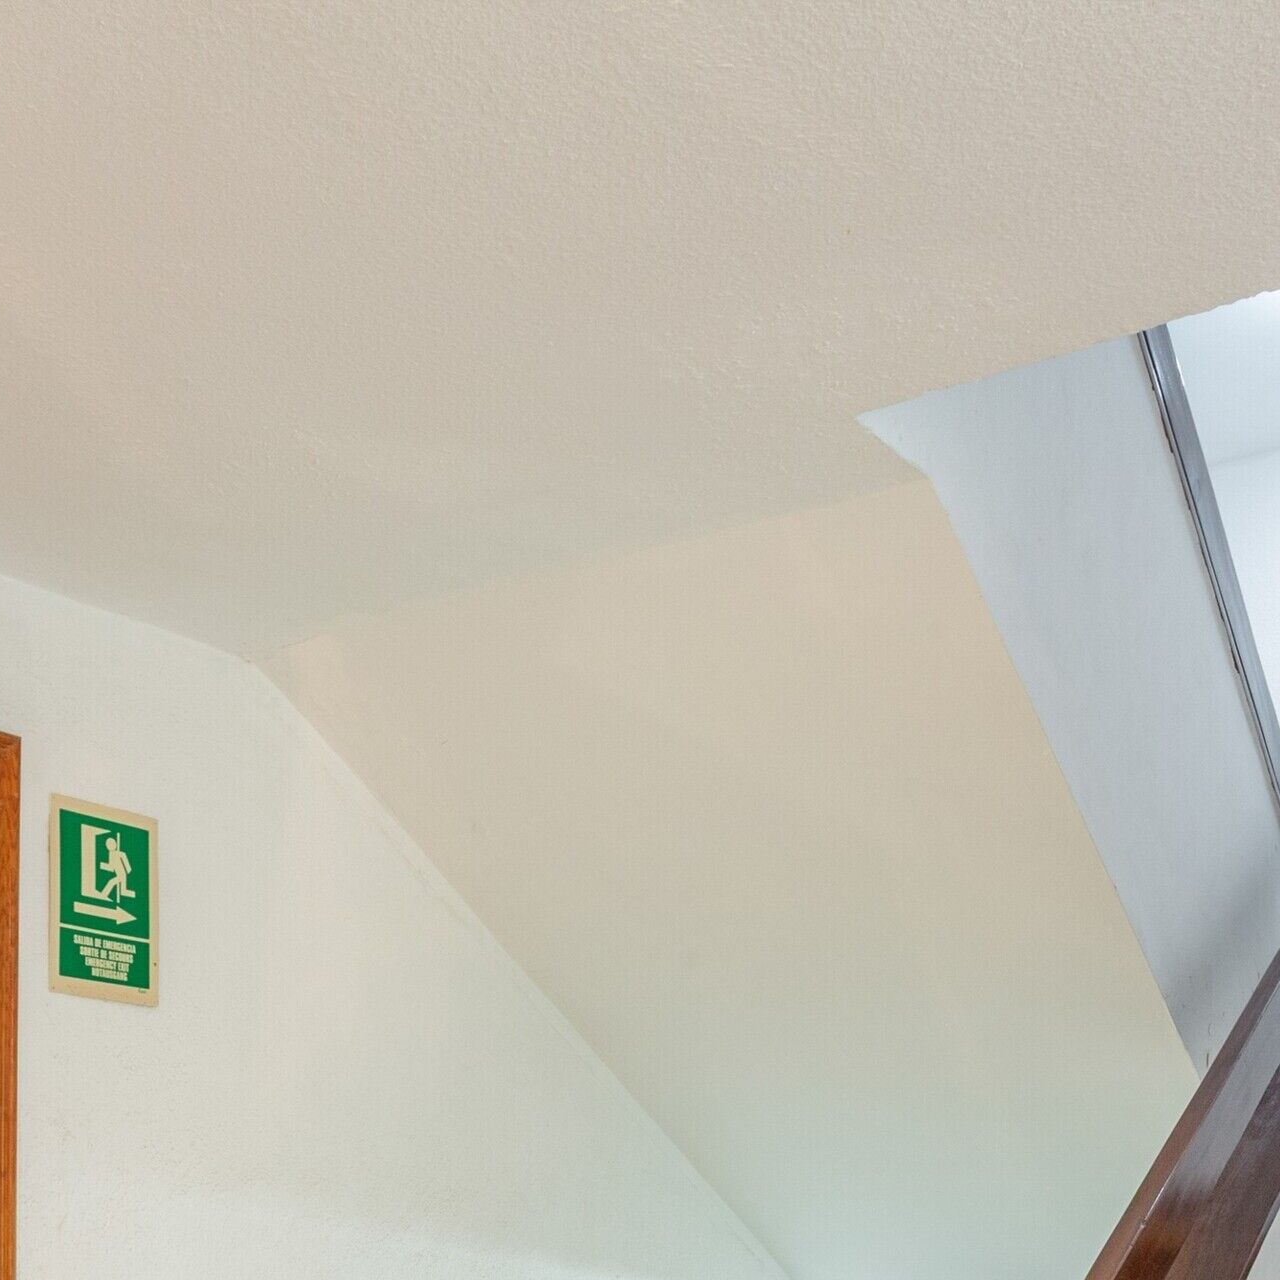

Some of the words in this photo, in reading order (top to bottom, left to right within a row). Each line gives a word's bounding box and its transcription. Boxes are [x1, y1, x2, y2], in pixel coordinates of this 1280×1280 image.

[94, 938, 102, 948] DE
[102, 939, 136, 954] EMERGENCIA
[100, 949, 108, 959] DE
